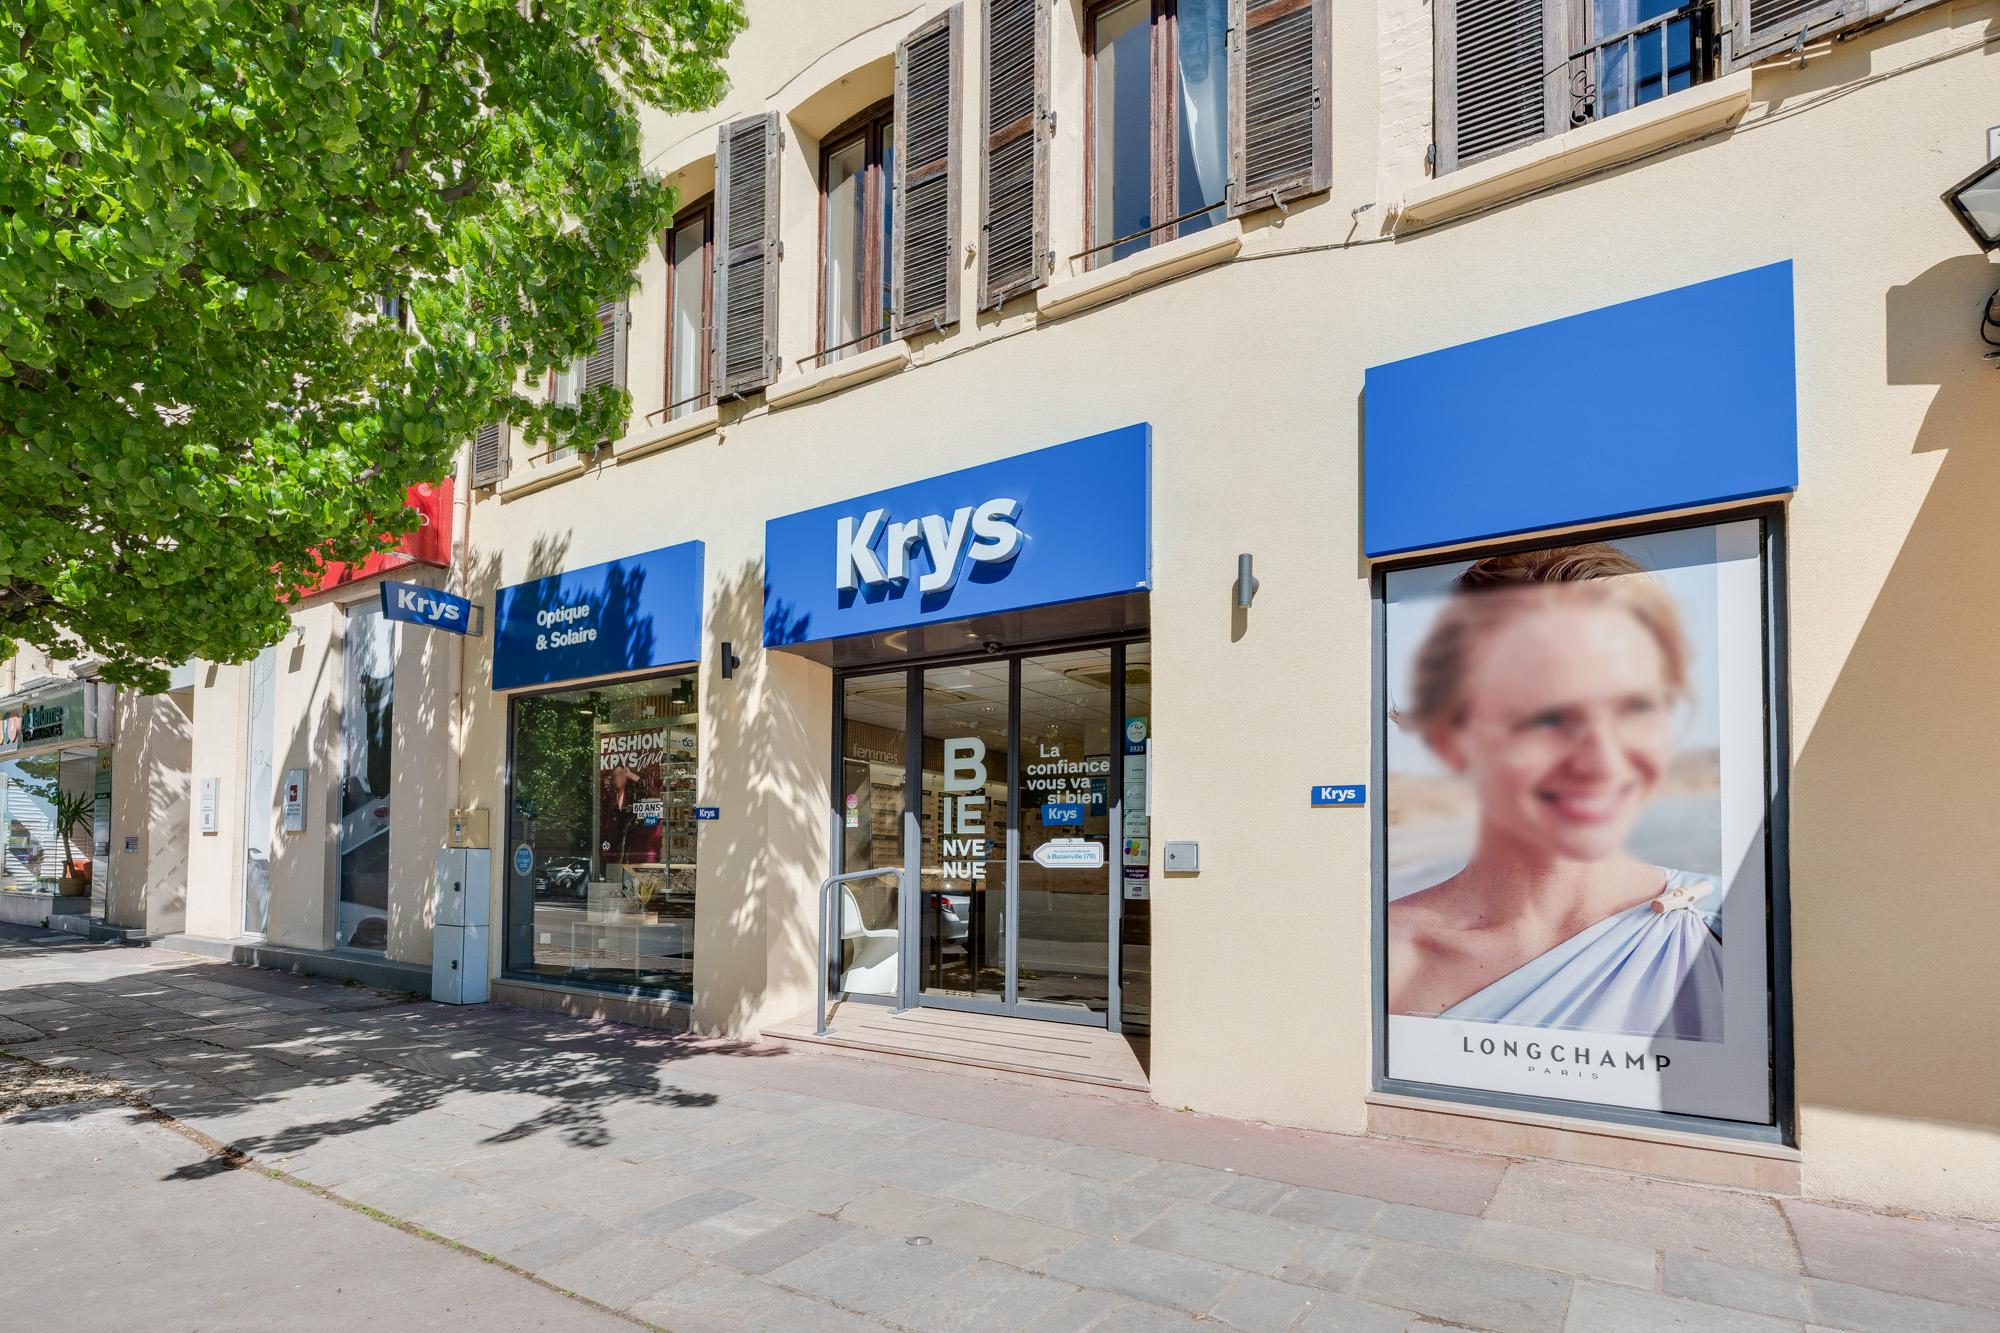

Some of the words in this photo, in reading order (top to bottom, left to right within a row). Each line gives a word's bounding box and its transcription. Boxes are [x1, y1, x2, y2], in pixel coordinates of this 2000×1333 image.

[835, 497, 1021, 595] Krys
[397, 588, 460, 621] Krys
[536, 604, 590, 629] Optique
[535, 634, 549, 651] &
[549, 626, 598, 648] Solaire
[600, 732, 667, 754] FASHION
[1040, 743, 1061, 758] La
[853, 744, 898, 764] femmes
[1026, 759, 1111, 775] confiance
[1026, 778, 1066, 791] vous
[1070, 777, 1091, 789] va
[1047, 791, 1061, 804] si
[1065, 790, 1103, 804] bien
[1321, 787, 1356, 802] Krys
[634, 804, 644, 812] 60
[645, 803, 661, 812] ANS
[699, 809, 715, 819] Krys
[1048, 807, 1078, 822] Krys
[1463, 1036, 1672, 1072] LONGCHAMP
[1528, 1066, 1599, 1080] PARIS
